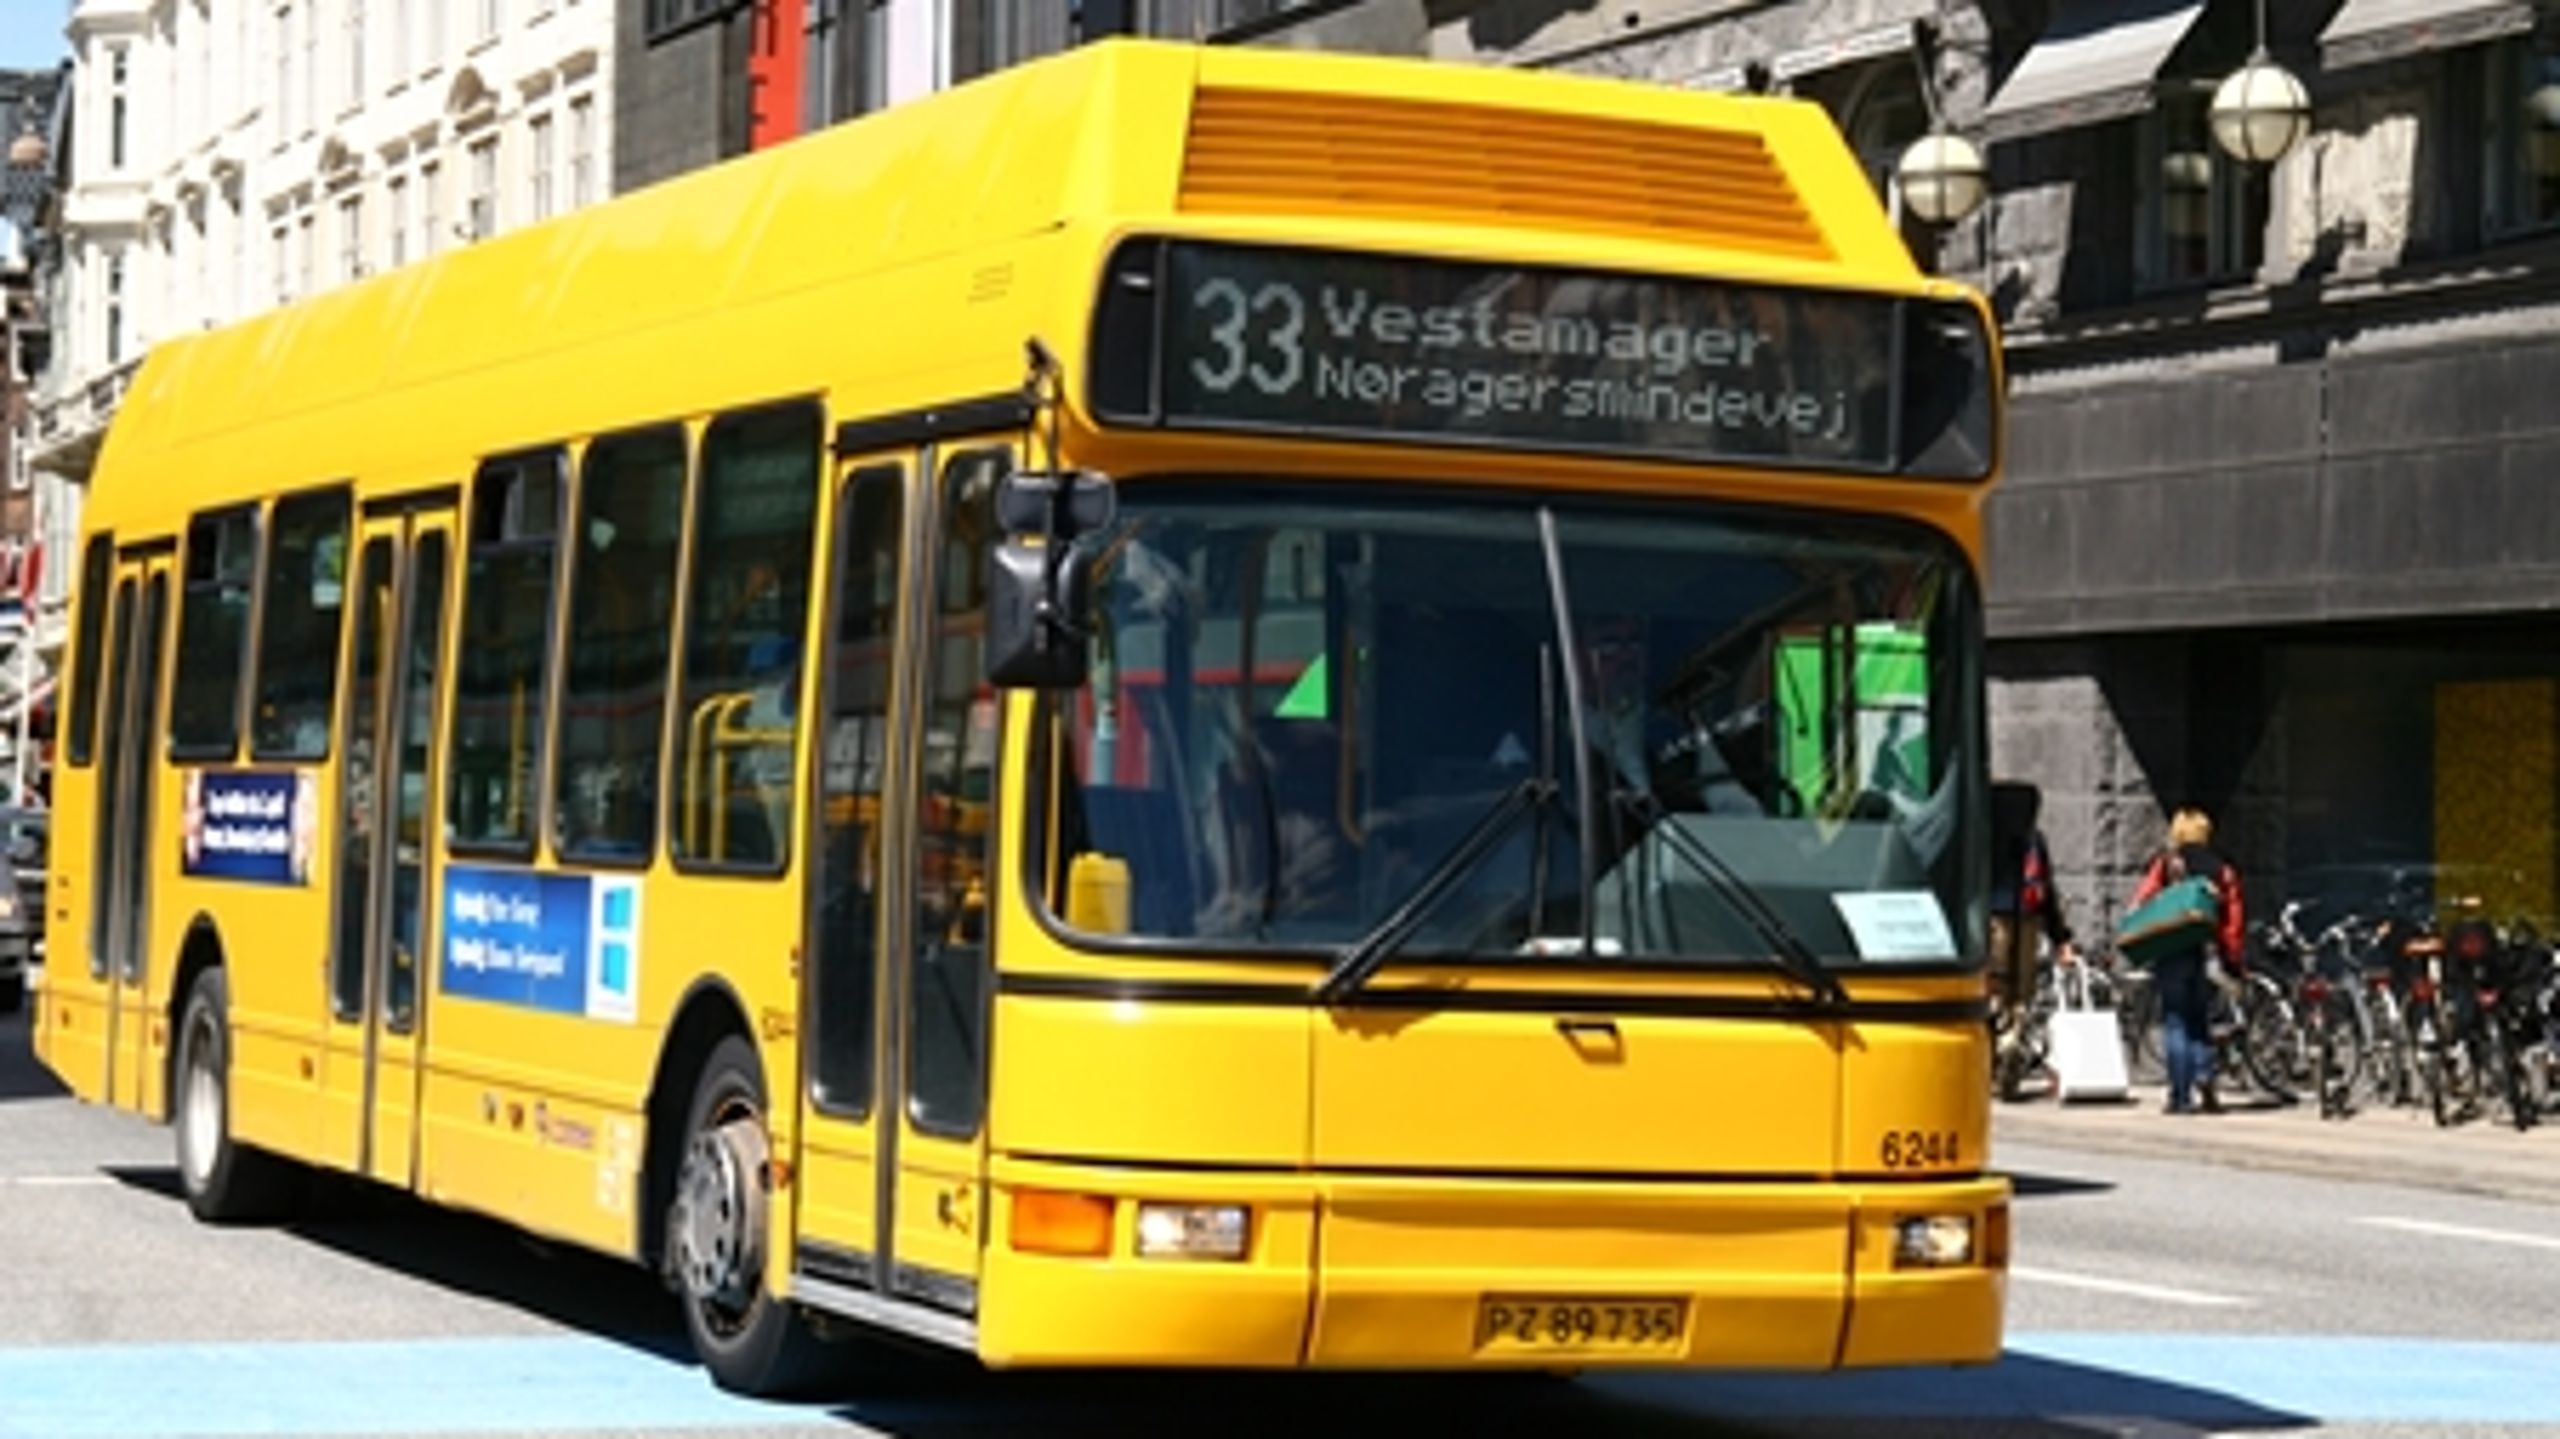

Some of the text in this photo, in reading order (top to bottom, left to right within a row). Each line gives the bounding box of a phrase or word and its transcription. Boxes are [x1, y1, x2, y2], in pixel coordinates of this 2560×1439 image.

[1190, 276, 1305, 396] 33
[1320, 286, 1771, 375] Vestamager
[1314, 352, 1847, 439] Nøragersmindevej
[1880, 1130, 1959, 1168] 6244
[1488, 1305, 1674, 1344] PZ 89 735
